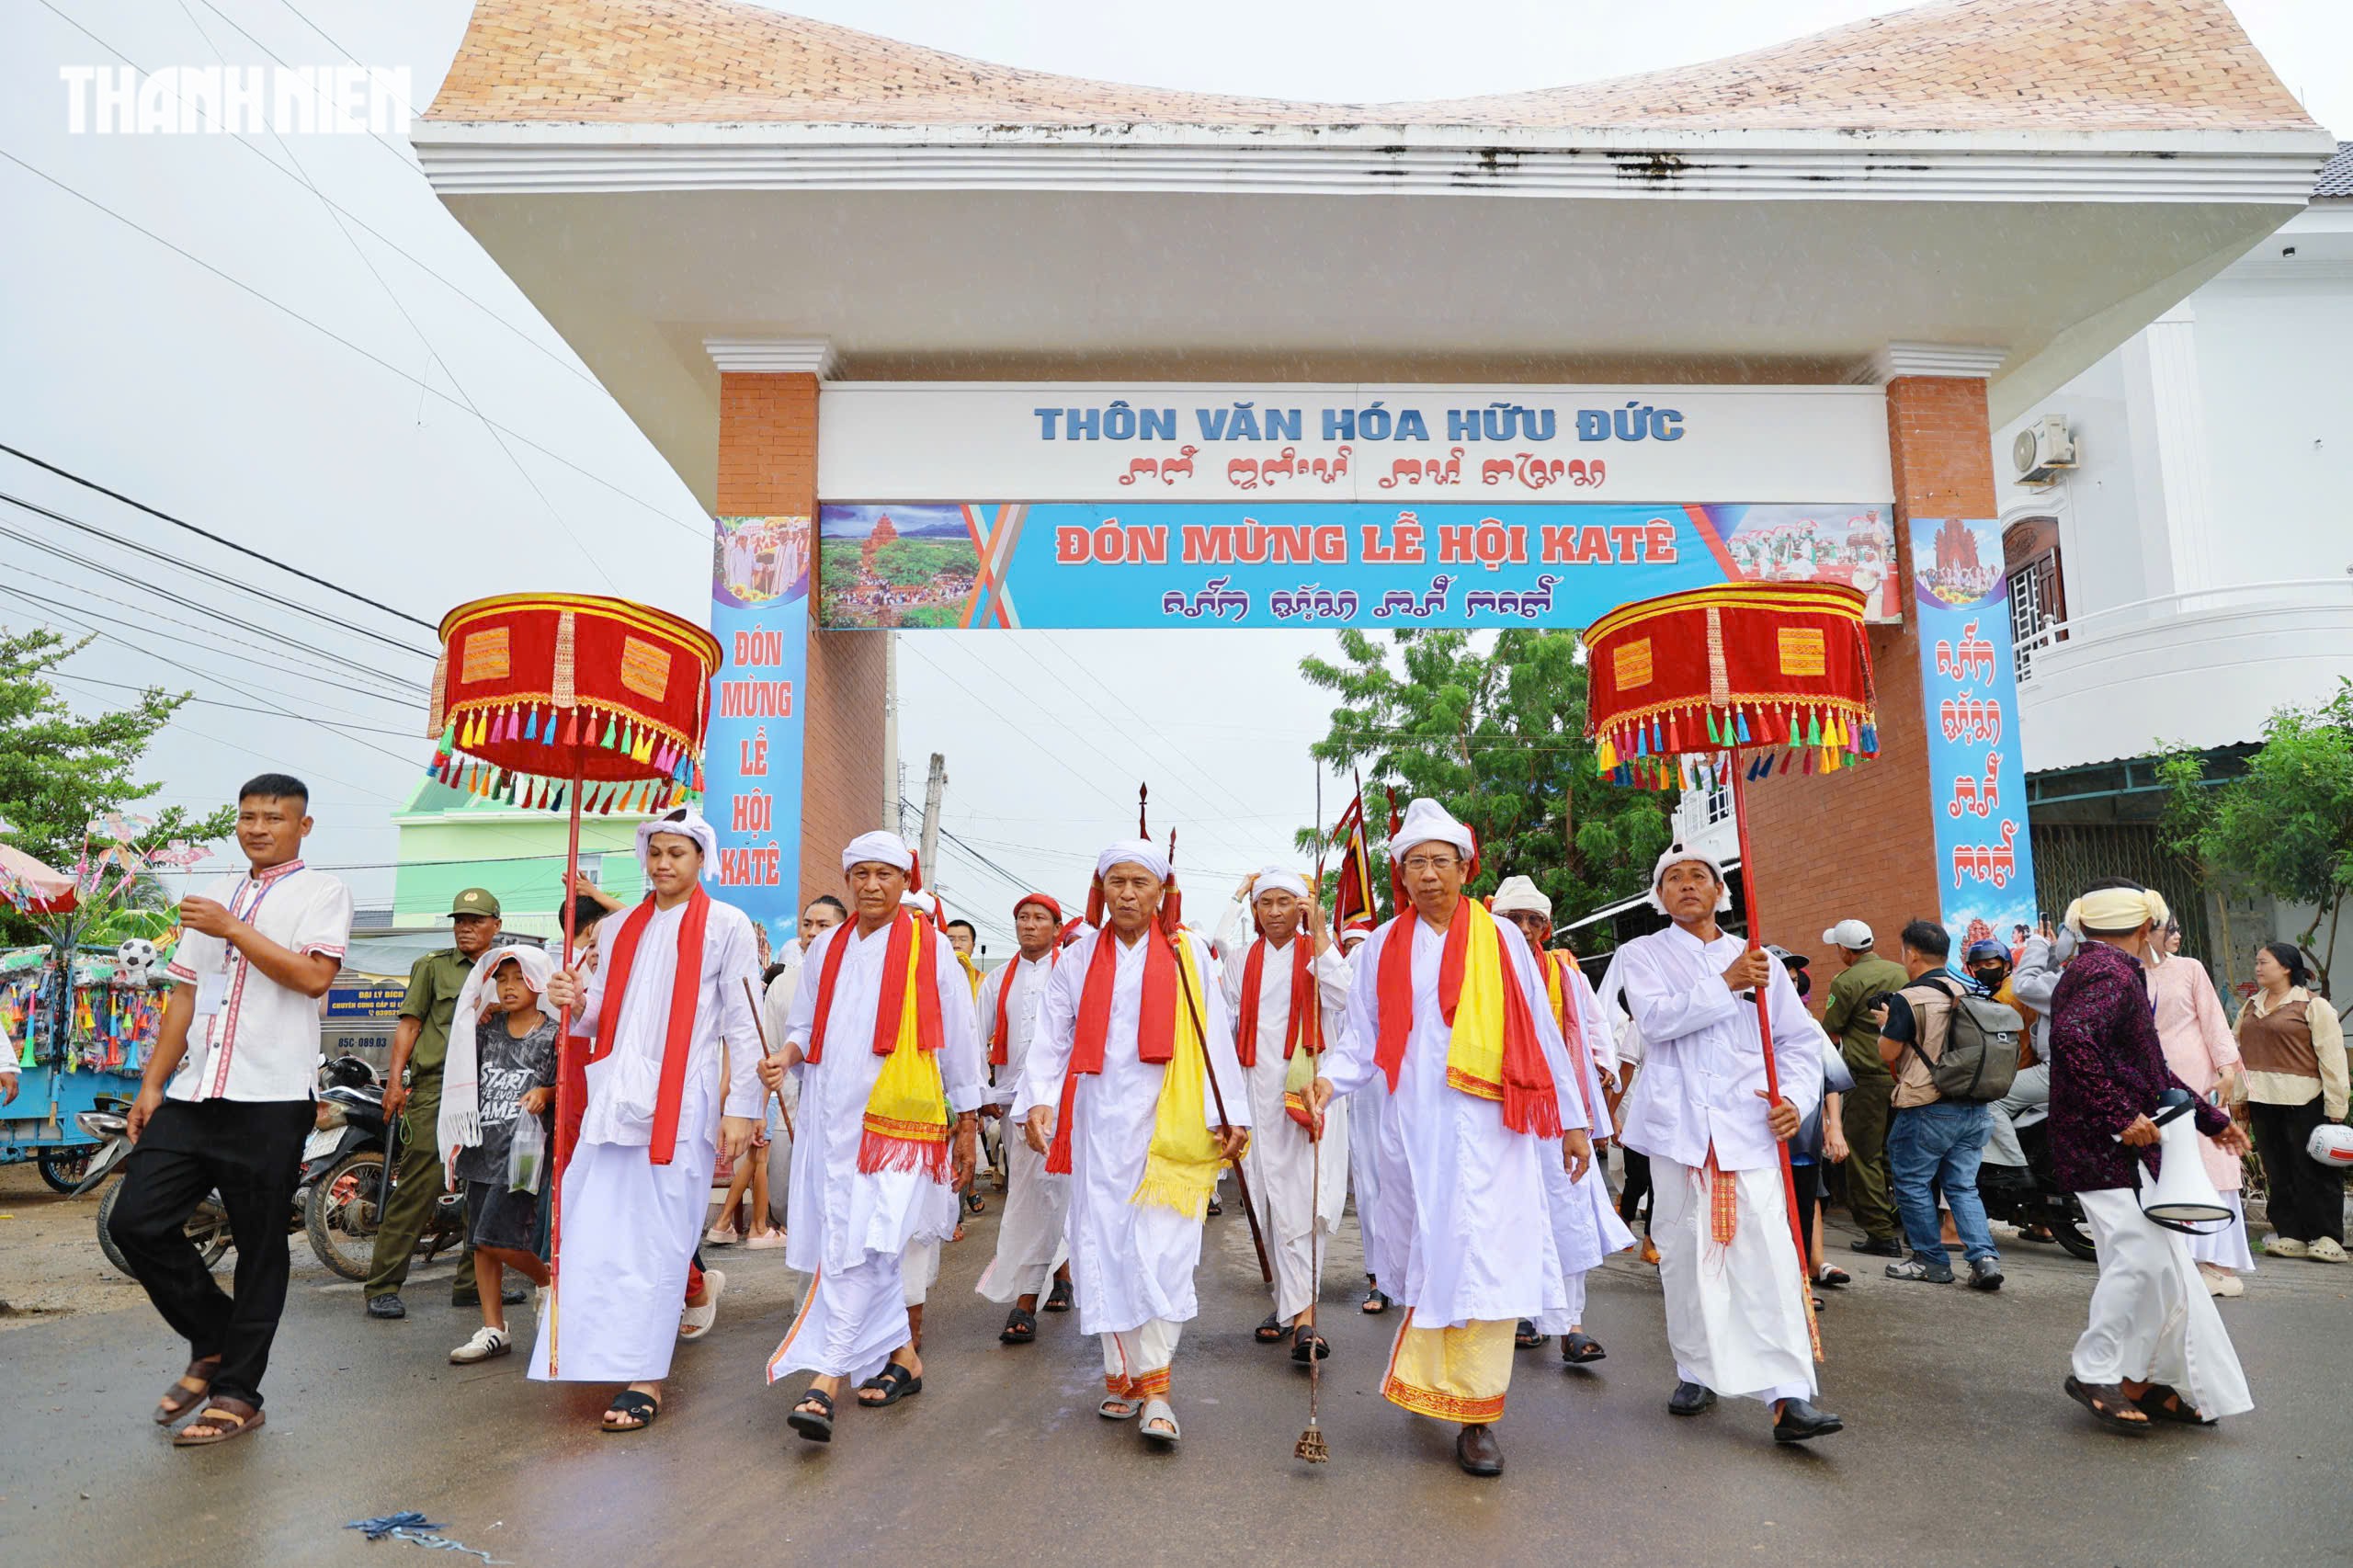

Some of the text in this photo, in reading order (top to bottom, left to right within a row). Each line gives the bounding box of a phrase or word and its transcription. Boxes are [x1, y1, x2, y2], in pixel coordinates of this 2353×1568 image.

[1034, 400, 1685, 441] THÔN VĂN HÓA HỮU ĐỨC
[1056, 511, 1677, 572] ĐÓN MỪNG LỄ HỘI KATÊ
[733, 623, 783, 667] ĐÓN
[720, 674, 793, 718] MỪNG
[739, 726, 768, 777] LỄ
[732, 787, 773, 840] HỘI
[720, 840, 780, 887] KATÊ
[480, 1062, 535, 1090] START
